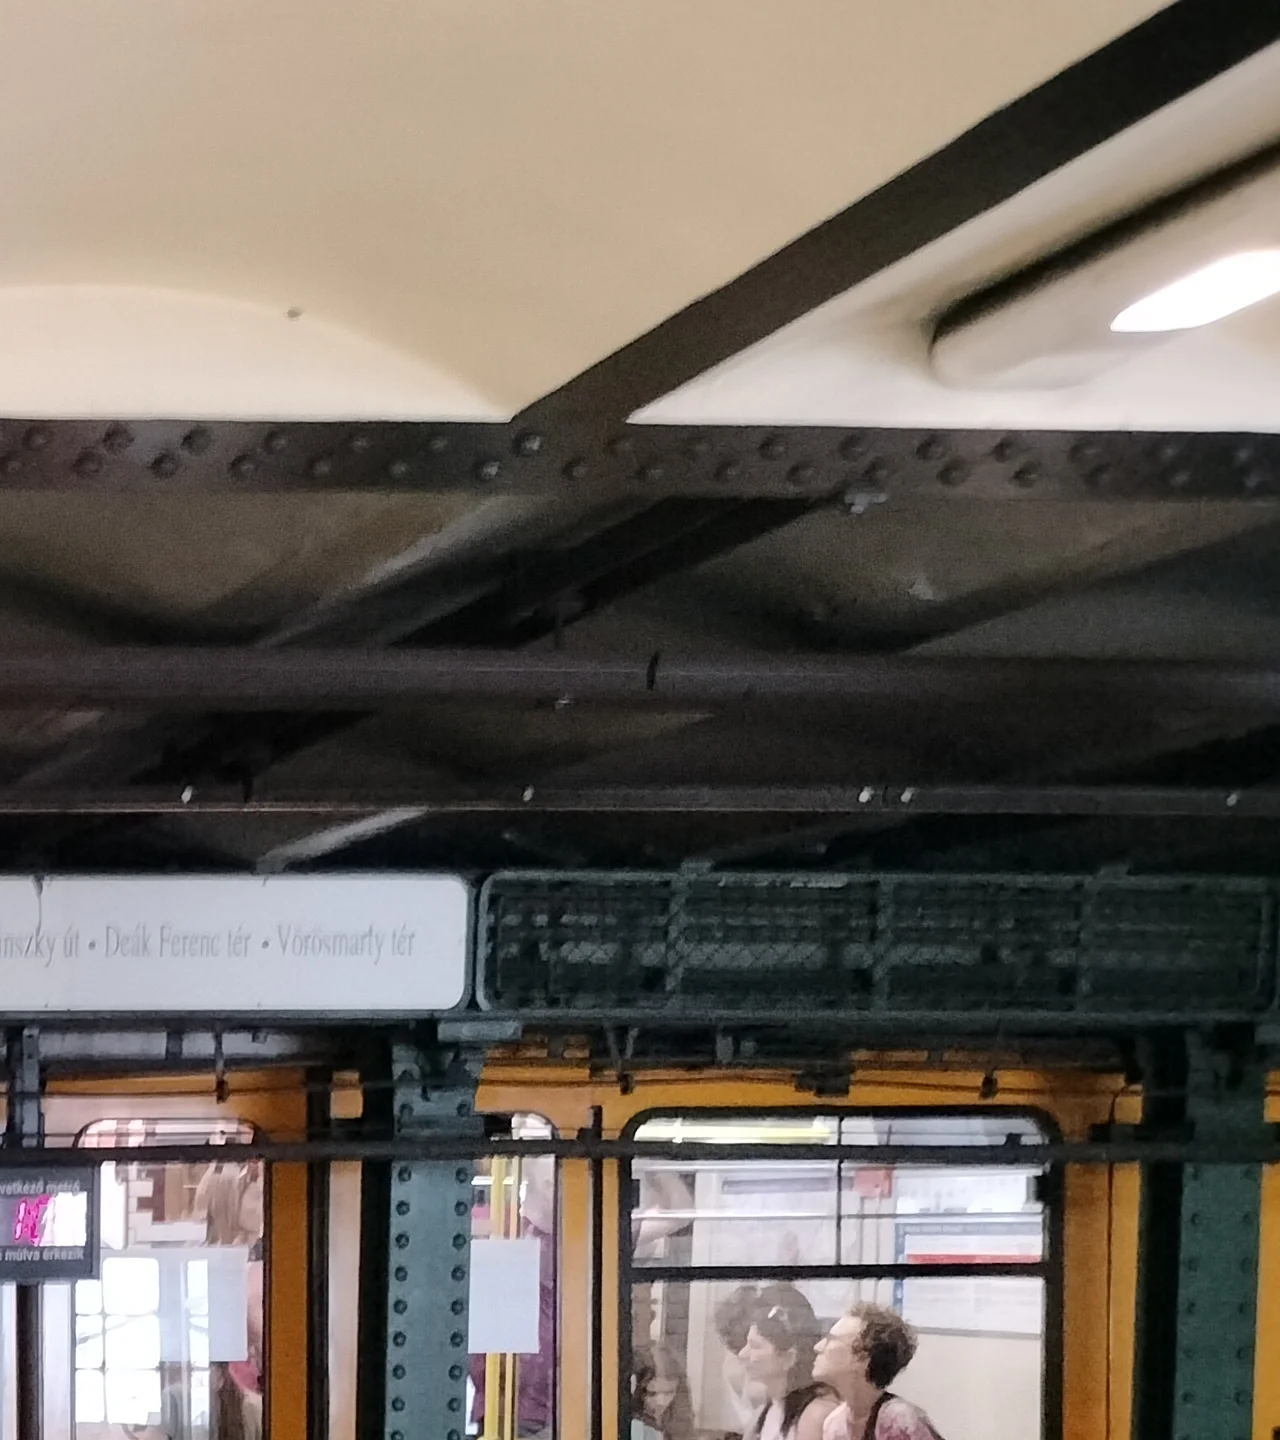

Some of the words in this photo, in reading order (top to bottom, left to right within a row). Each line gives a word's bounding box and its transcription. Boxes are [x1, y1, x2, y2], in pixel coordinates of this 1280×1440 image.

[63, 923, 80, 958] út
[105, 922, 150, 957] Deák
[160, 923, 219, 957] Ferenc
[227, 924, 251, 957] tér
[392, 922, 416, 957] tér
